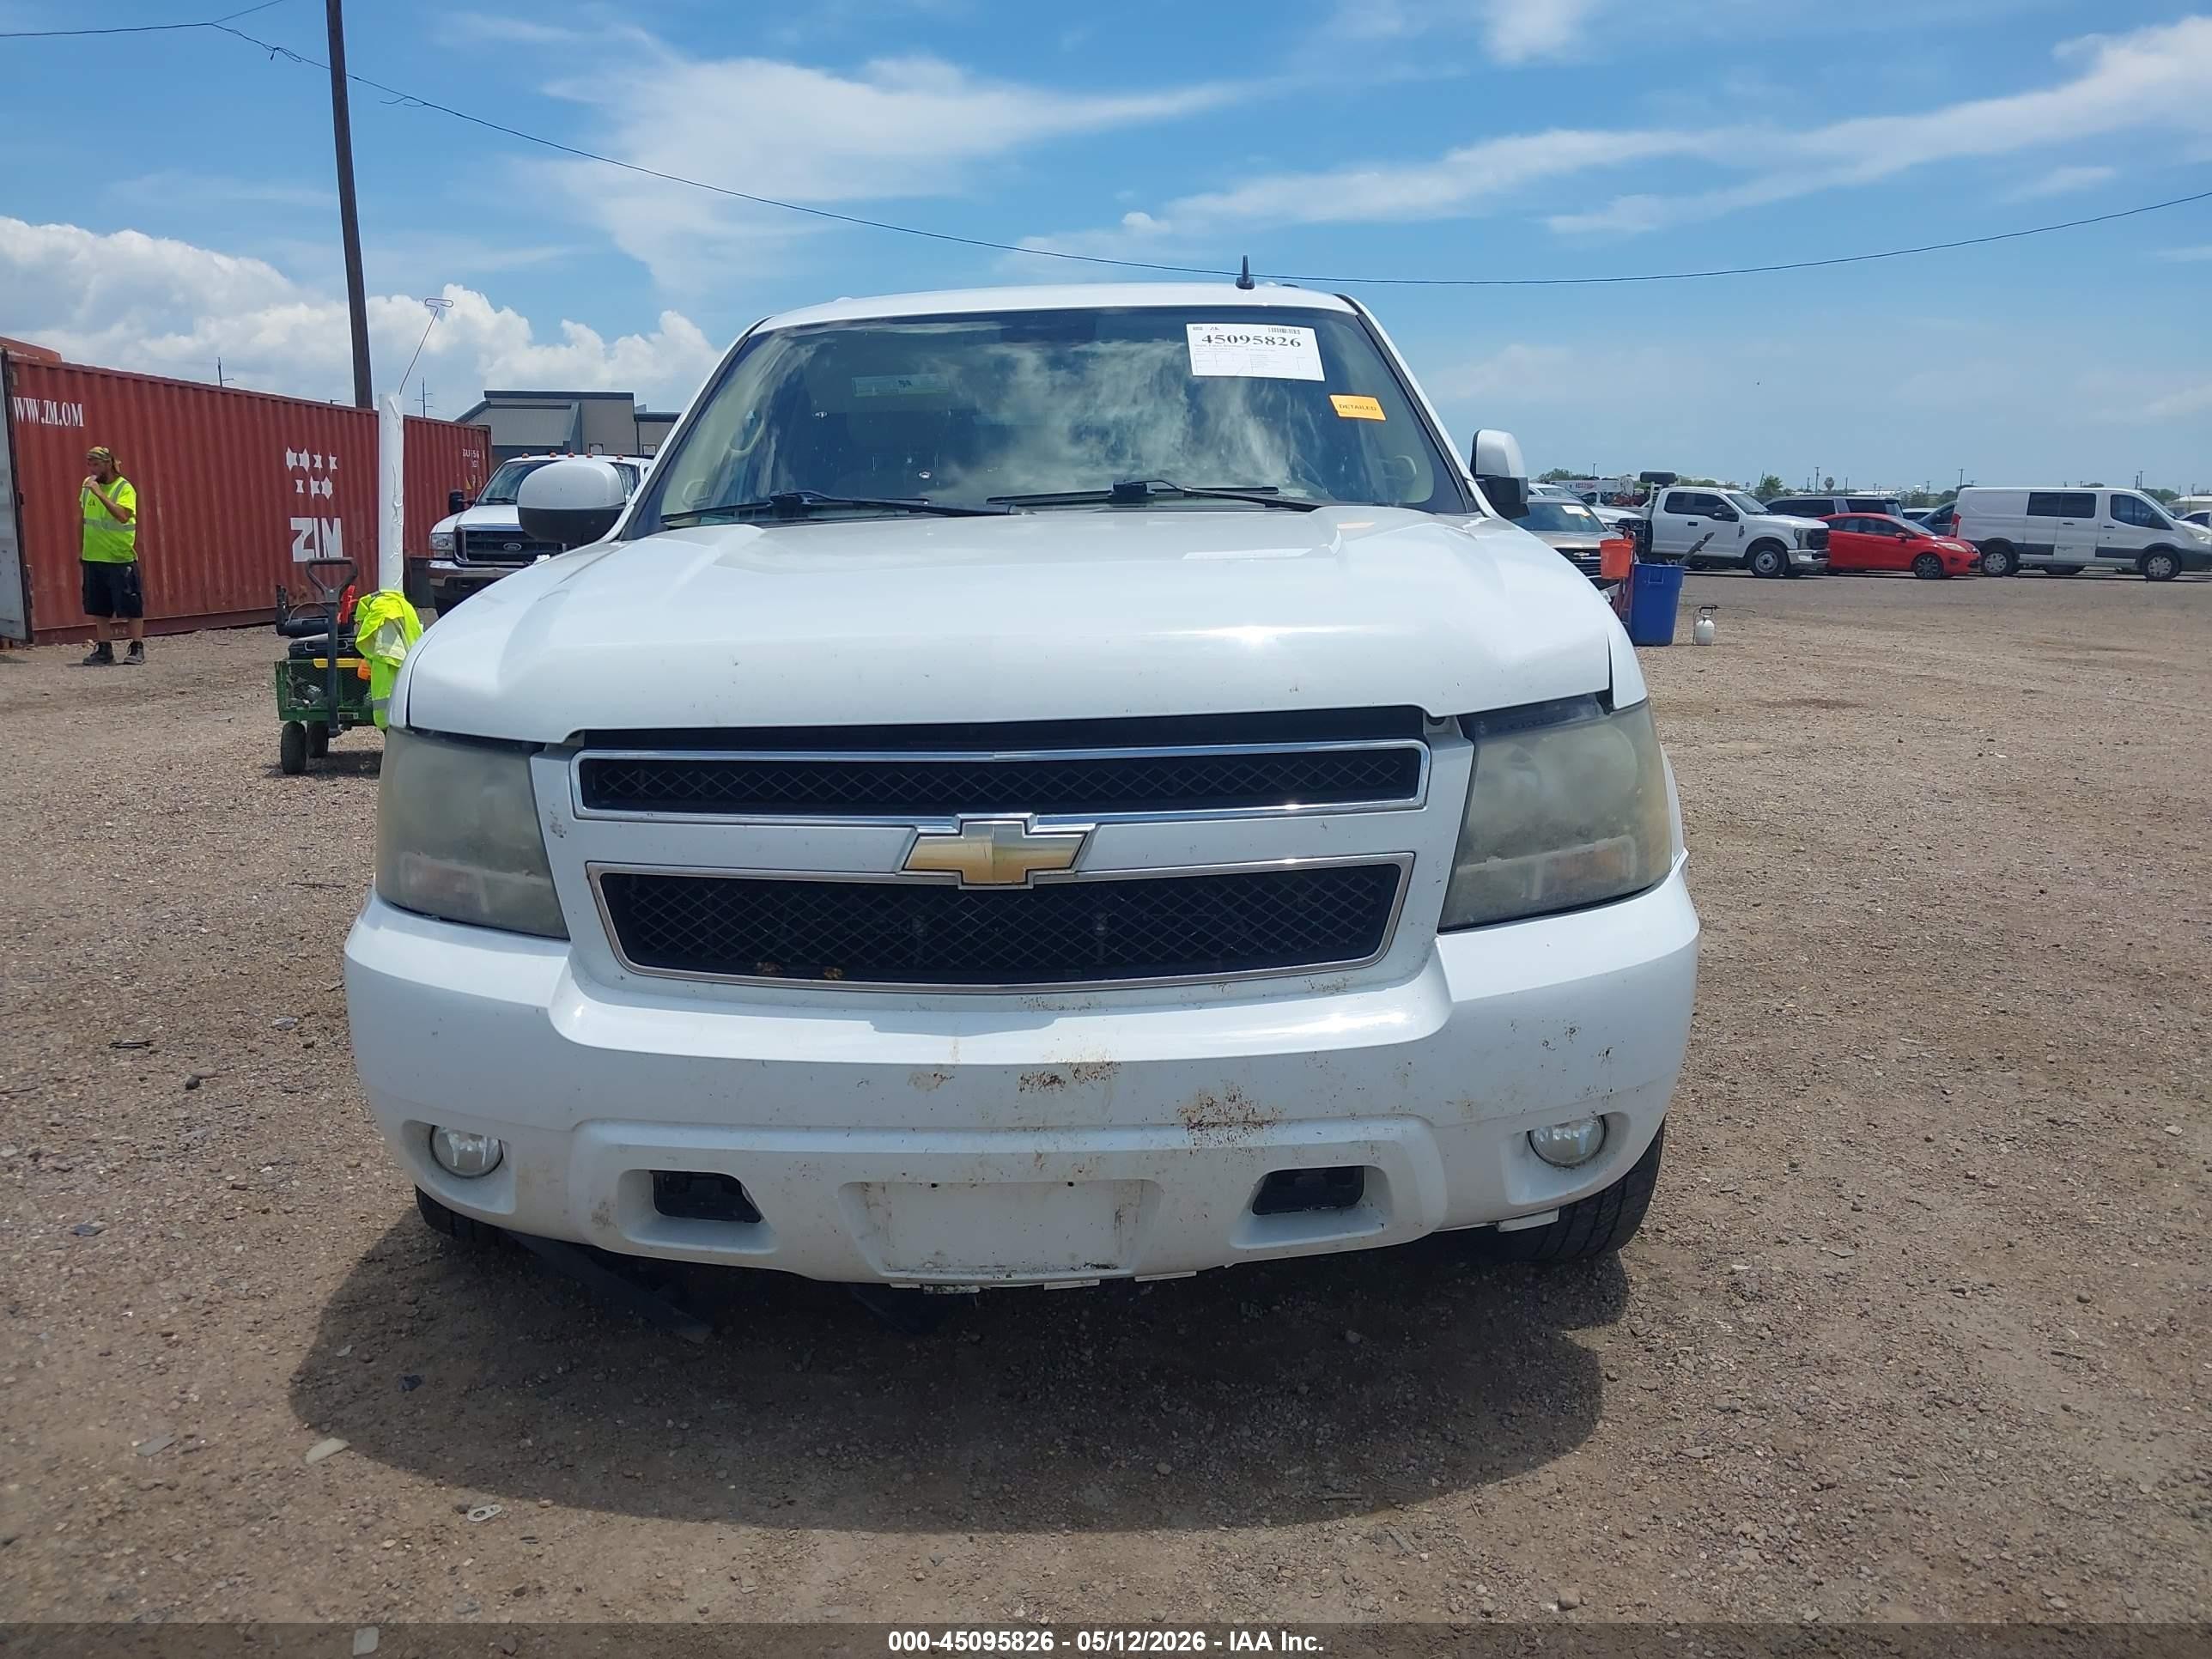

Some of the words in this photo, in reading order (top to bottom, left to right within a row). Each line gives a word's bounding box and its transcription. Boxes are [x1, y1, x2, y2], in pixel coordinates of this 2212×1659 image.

[1201, 334, 1302, 348] 45095826
[1339, 404, 1377, 412] DETAILED
[290, 518, 343, 562] ZIM
